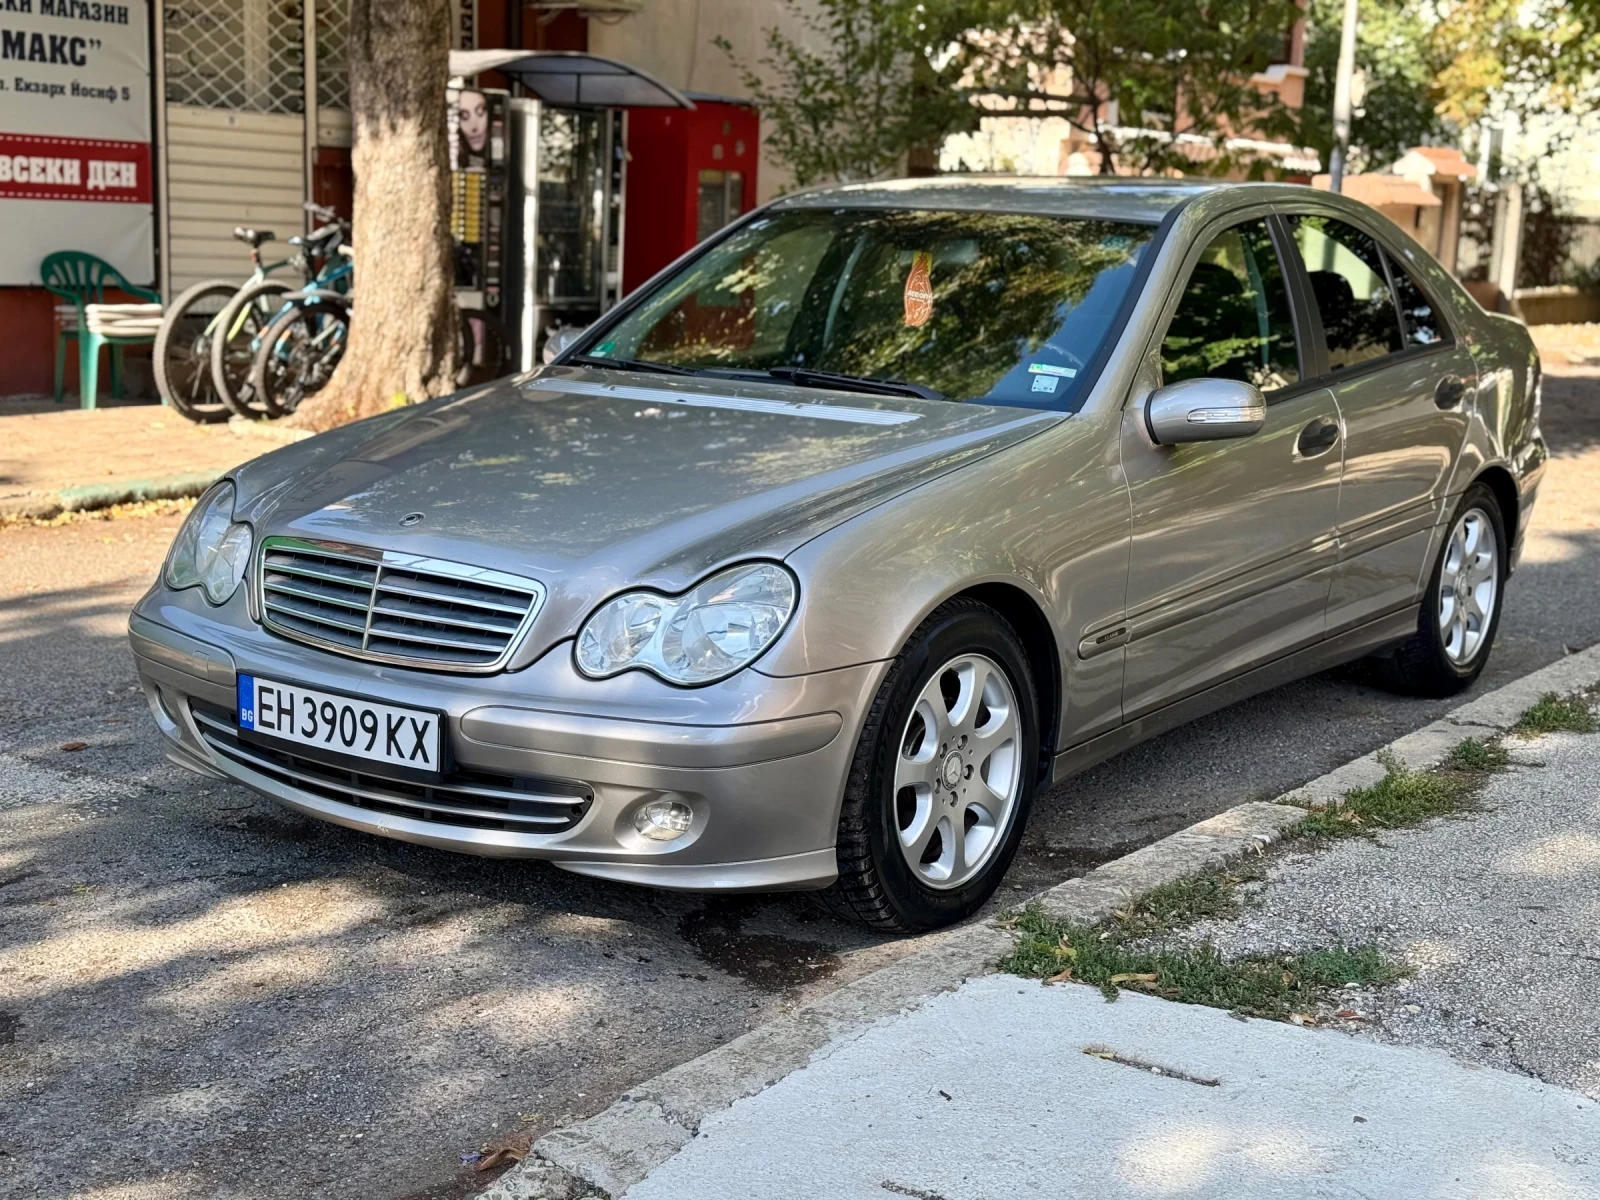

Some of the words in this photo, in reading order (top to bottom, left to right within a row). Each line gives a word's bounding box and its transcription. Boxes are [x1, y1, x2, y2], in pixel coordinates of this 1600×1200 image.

[0, 0, 32, 13] КИ
[40, 0, 129, 24] МАГАЗИН
[15, 77, 66, 98] Екзарх
[71, 80, 117, 103] Йосиф
[121, 87, 130, 101] 5
[0, 154, 81, 185] ВСЕКИ
[87, 160, 137, 190] ДЕН
[241, 707, 253, 723] BG
